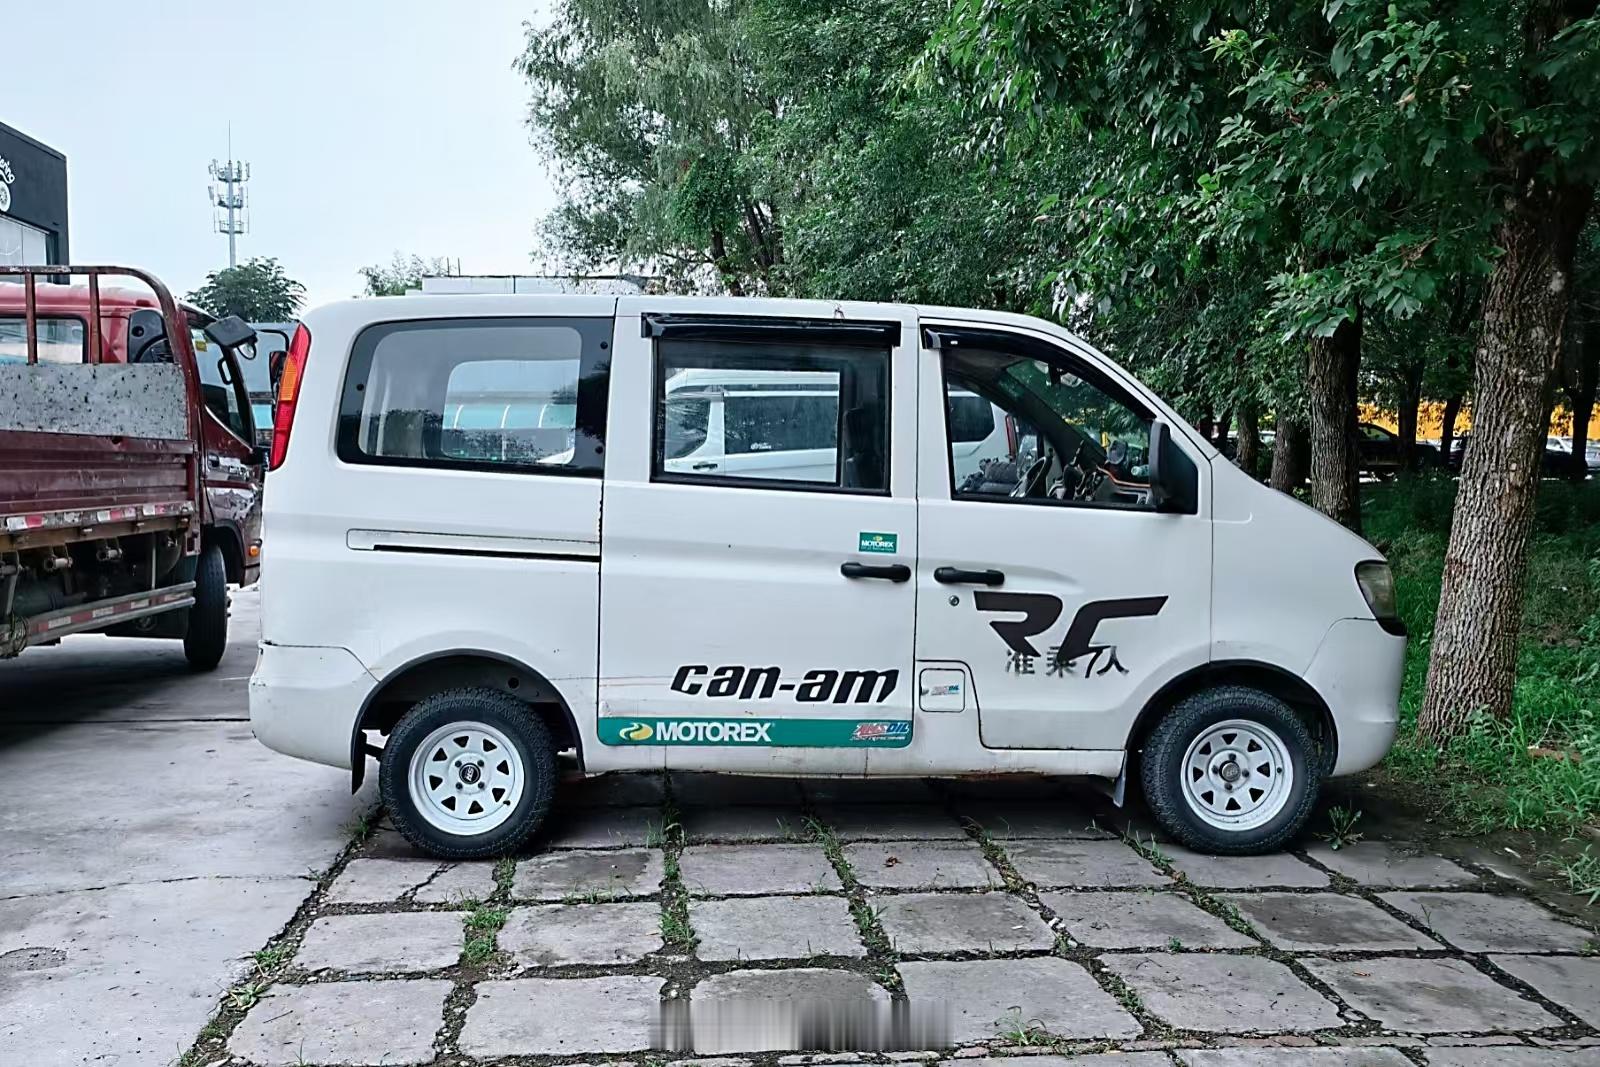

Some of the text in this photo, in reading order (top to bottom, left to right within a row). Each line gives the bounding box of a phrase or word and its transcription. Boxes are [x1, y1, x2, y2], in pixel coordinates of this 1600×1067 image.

[861, 540, 894, 548] MOTOREX
[670, 665, 899, 704] can-am
[656, 721, 773, 742] MOTOREX
